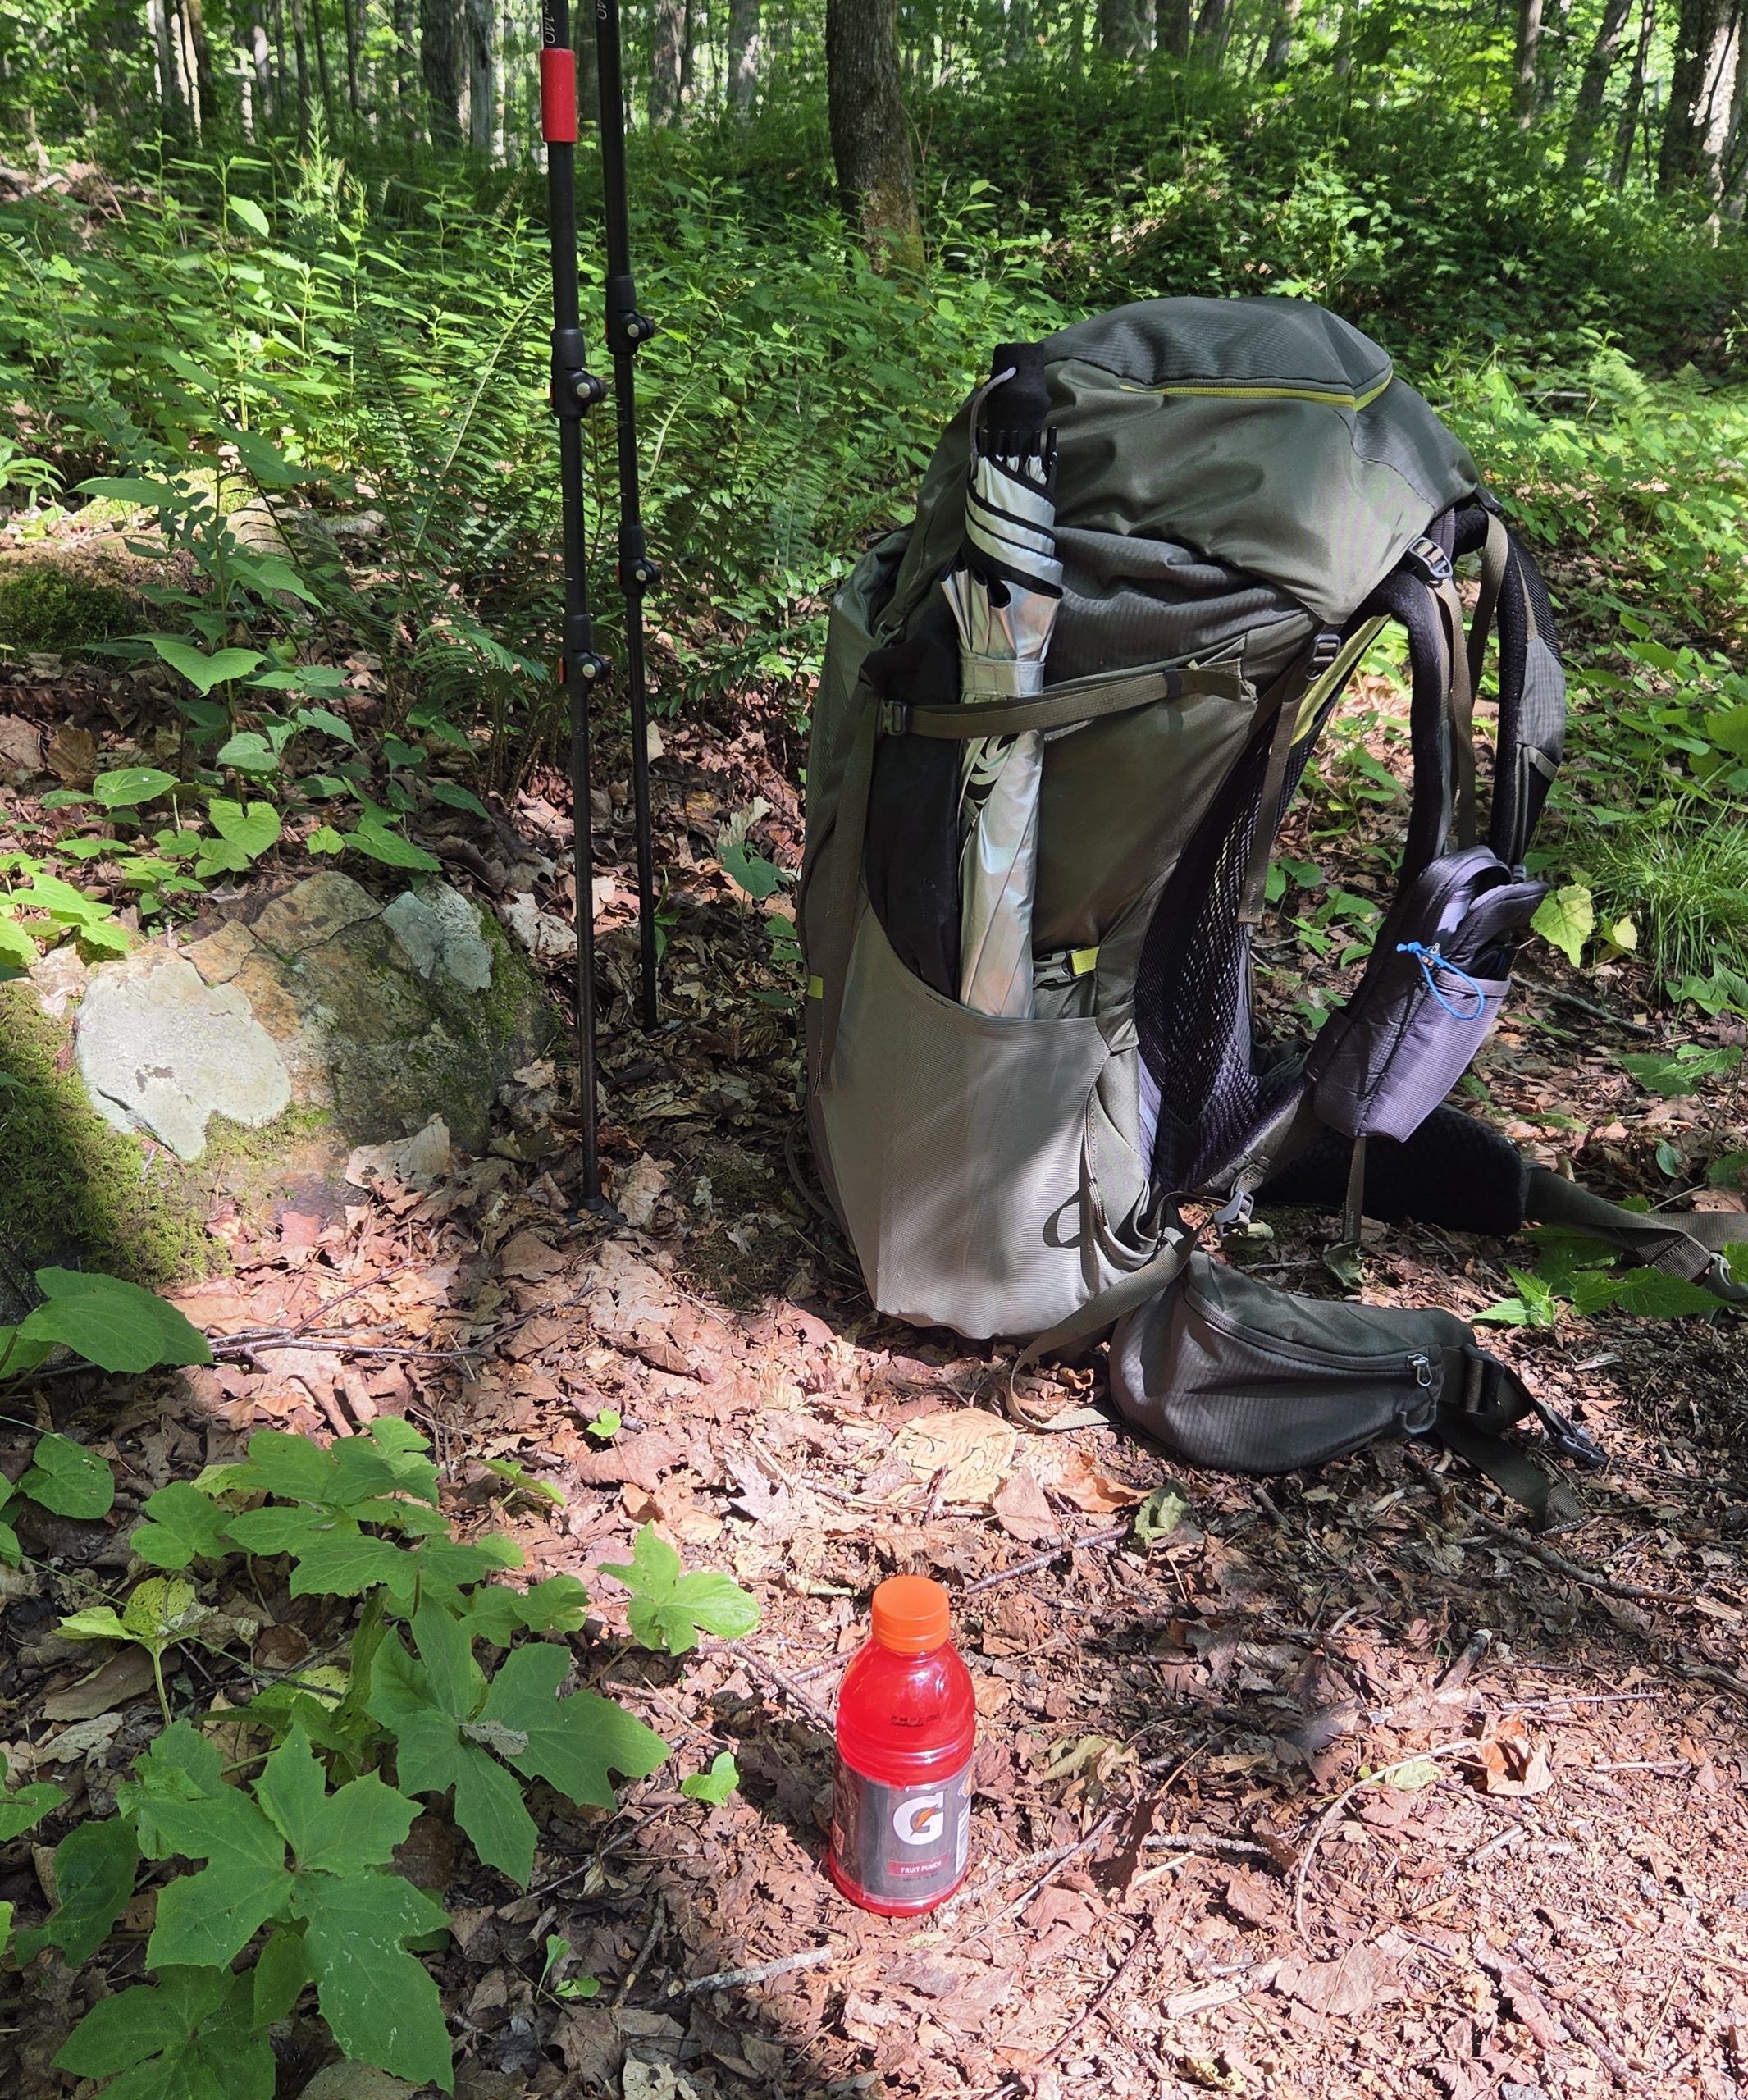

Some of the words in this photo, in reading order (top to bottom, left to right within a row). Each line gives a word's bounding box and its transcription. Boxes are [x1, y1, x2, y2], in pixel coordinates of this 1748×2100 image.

[544, 16, 556, 43] 140
[893, 1790, 944, 1846] G
[921, 1860, 942, 1872] PUNCH
